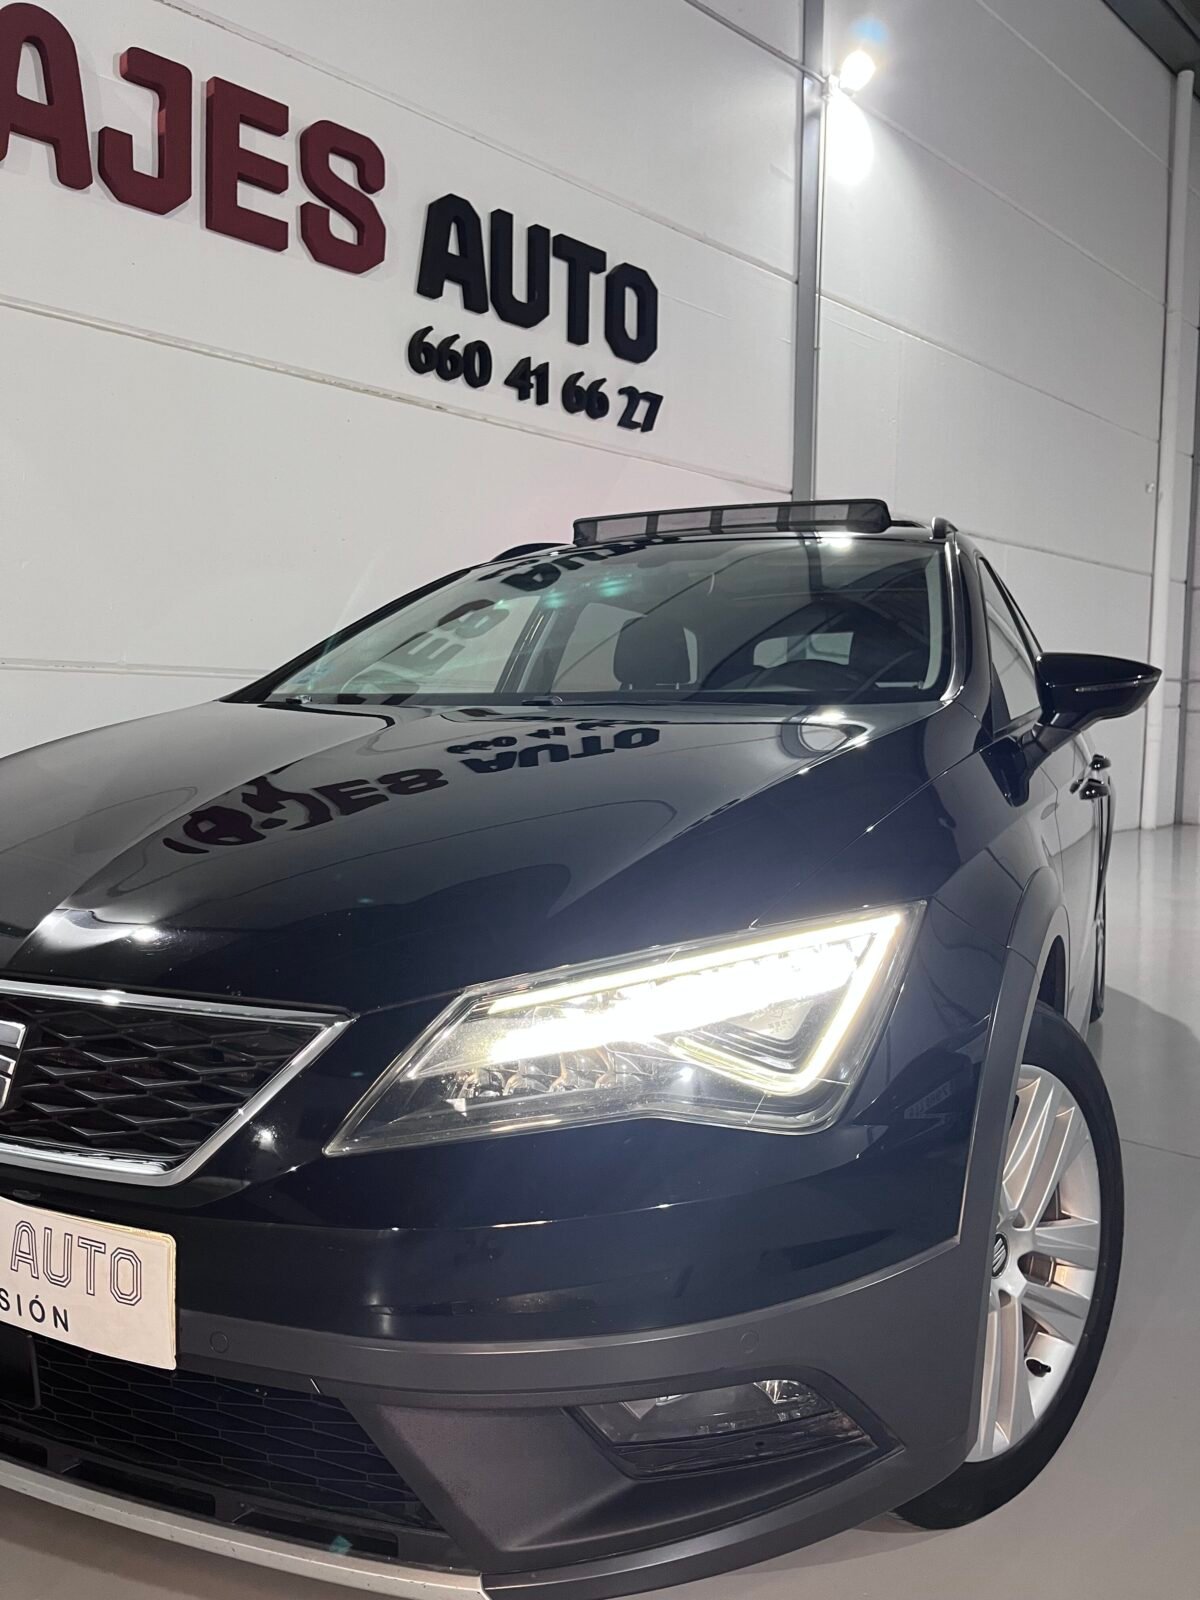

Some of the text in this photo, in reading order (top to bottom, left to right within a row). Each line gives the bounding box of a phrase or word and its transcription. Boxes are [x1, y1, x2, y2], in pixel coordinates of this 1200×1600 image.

[0, 2, 658, 364] AJES AUTO
[408, 326, 663, 432] 660 41 66 27
[0, 1288, 69, 1332] SIÓN
[10, 1221, 142, 1306] AUTO
